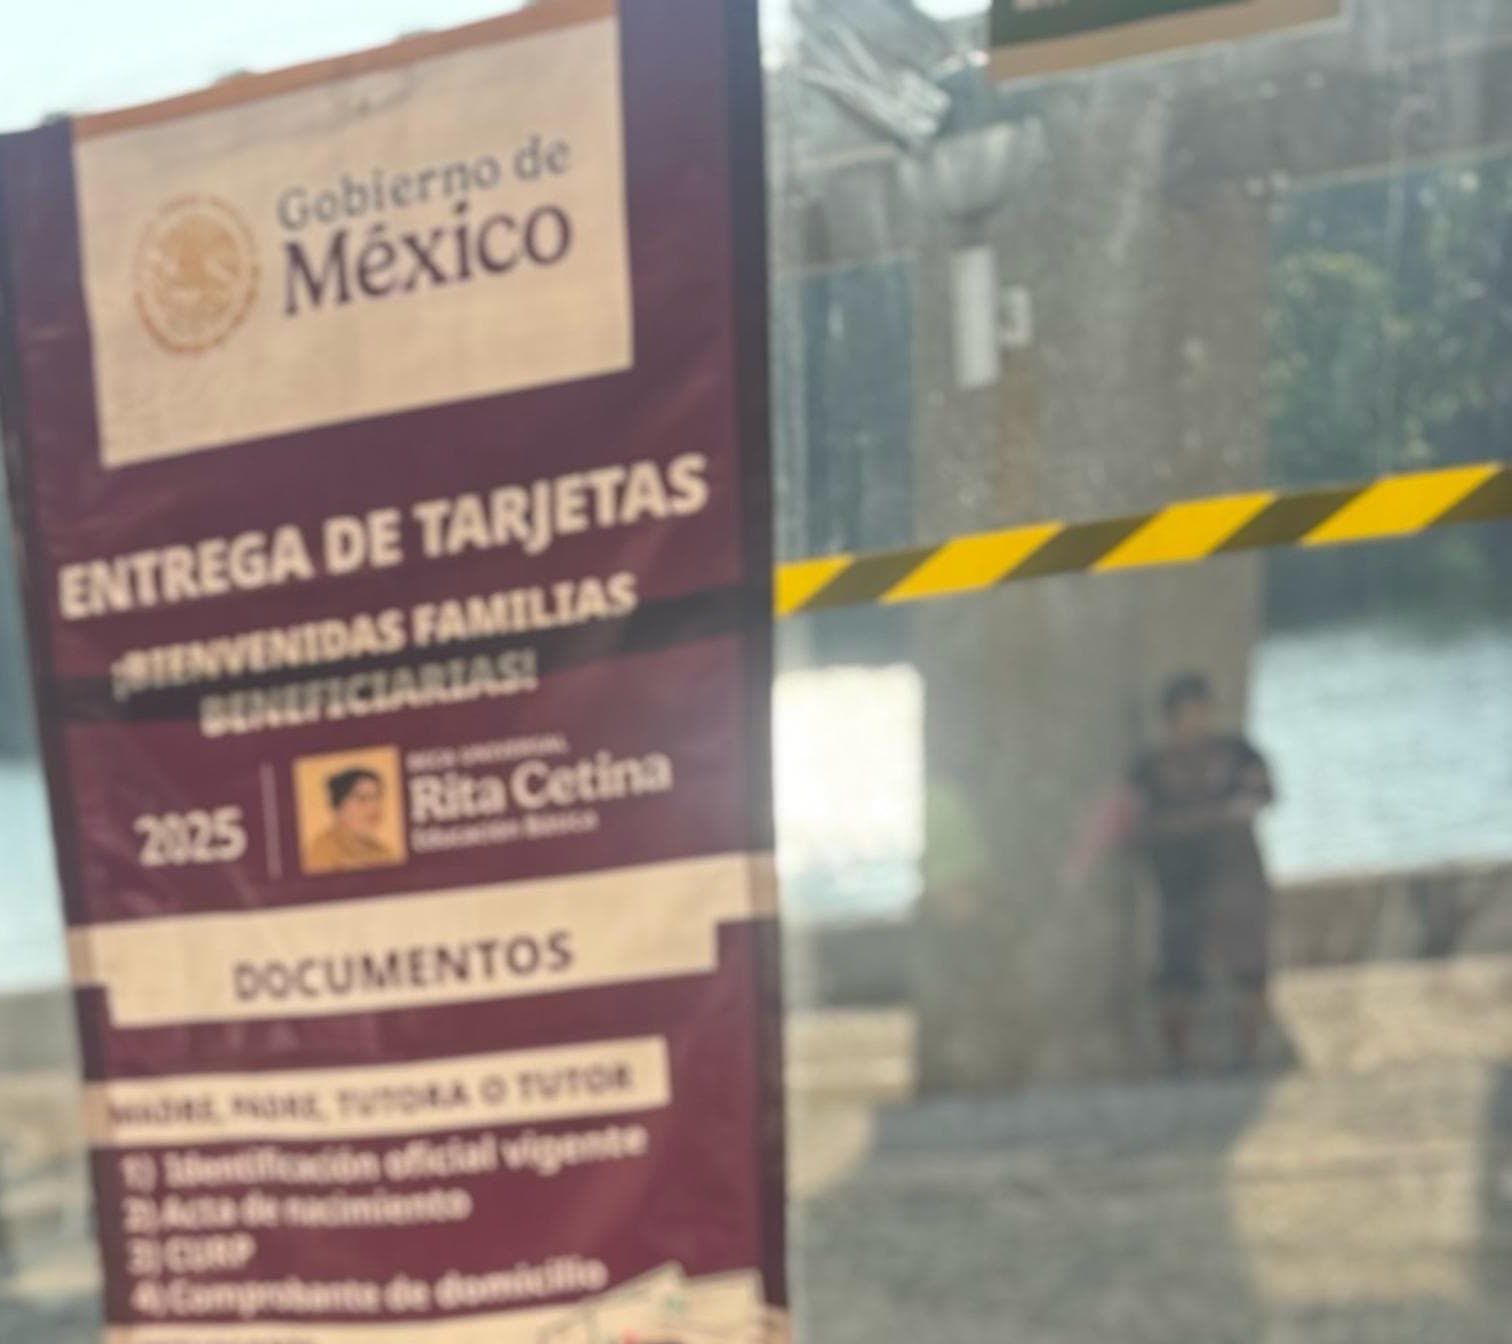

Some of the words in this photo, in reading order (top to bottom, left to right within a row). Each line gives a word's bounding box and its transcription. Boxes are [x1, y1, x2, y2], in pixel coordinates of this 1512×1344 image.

[277, 155, 501, 230] Gobierno
[513, 135, 571, 181] de
[284, 200, 572, 317] México
[58, 525, 314, 620] ENTREGA
[323, 509, 403, 573] DE
[413, 453, 710, 556] TARJETAS
[412, 572, 639, 646] FAMILIAS
[199, 650, 538, 738] BENEFICIARIAS!
[408, 769, 507, 823] Rita
[510, 749, 673, 808] Cetina
[133, 806, 248, 868] 2025
[233, 931, 574, 1001] DOCUMENTOS
[337, 1081, 467, 1119] TUTORA
[481, 1074, 506, 1103] O
[517, 1062, 634, 1098] TUTOR
[503, 1124, 648, 1176] vigente
